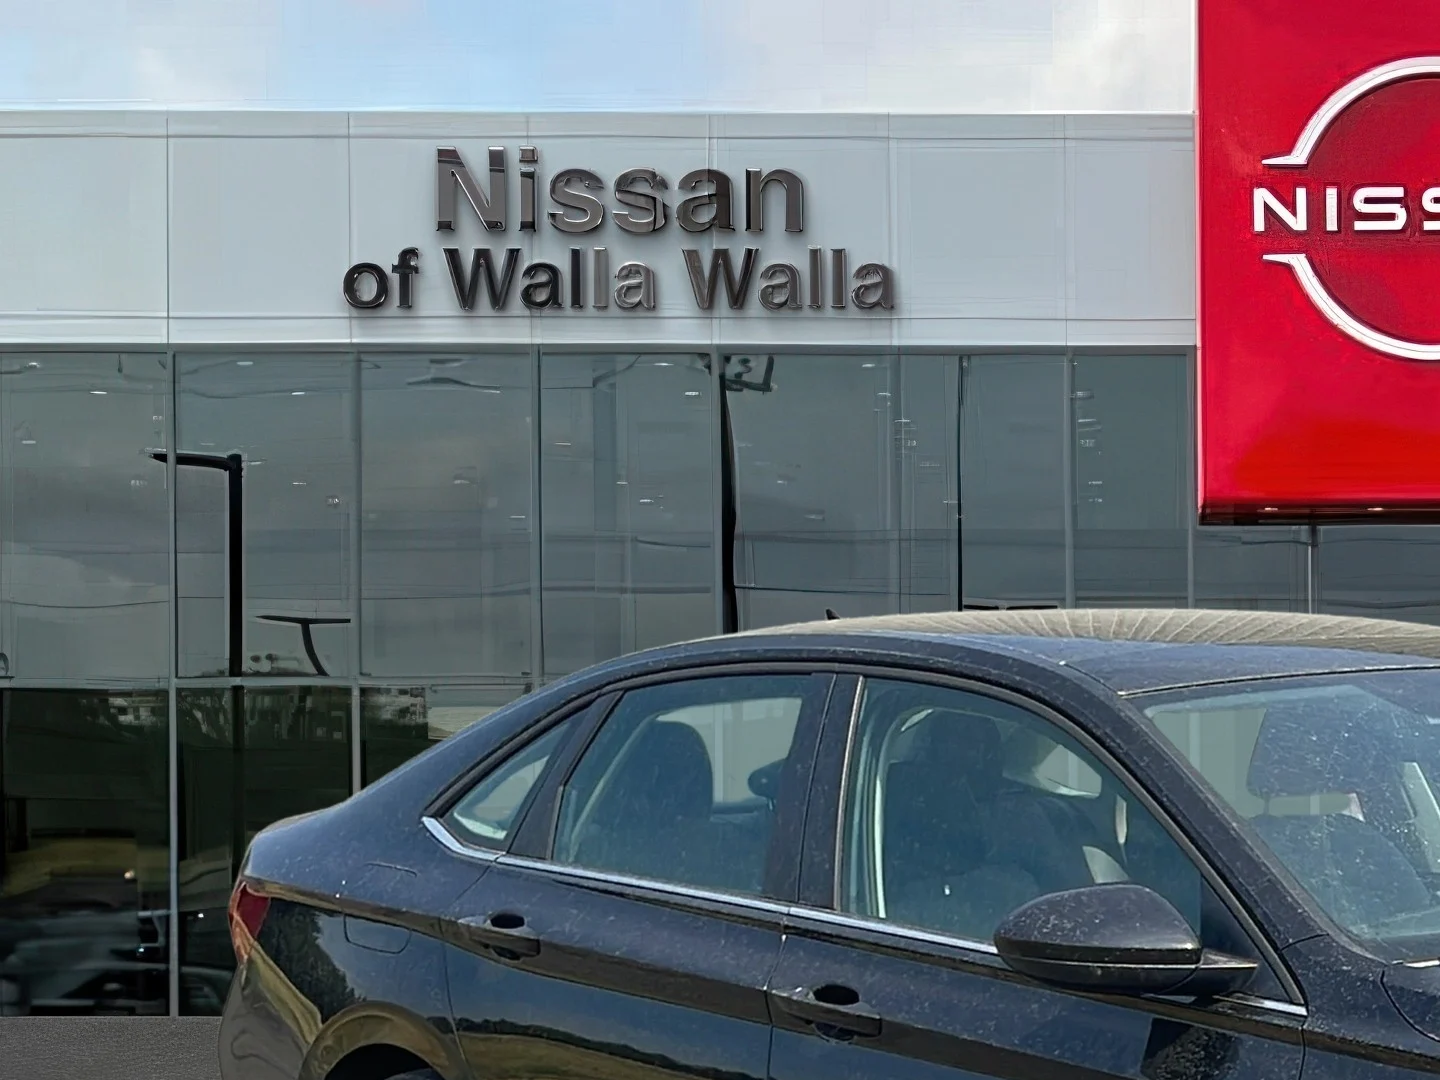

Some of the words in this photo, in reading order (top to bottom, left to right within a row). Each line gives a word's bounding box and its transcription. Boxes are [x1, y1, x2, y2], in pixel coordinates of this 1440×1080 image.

[434, 145, 806, 234] Nissan
[342, 247, 420, 309] of
[442, 246, 657, 311] Walla
[681, 245, 896, 311] Walla
